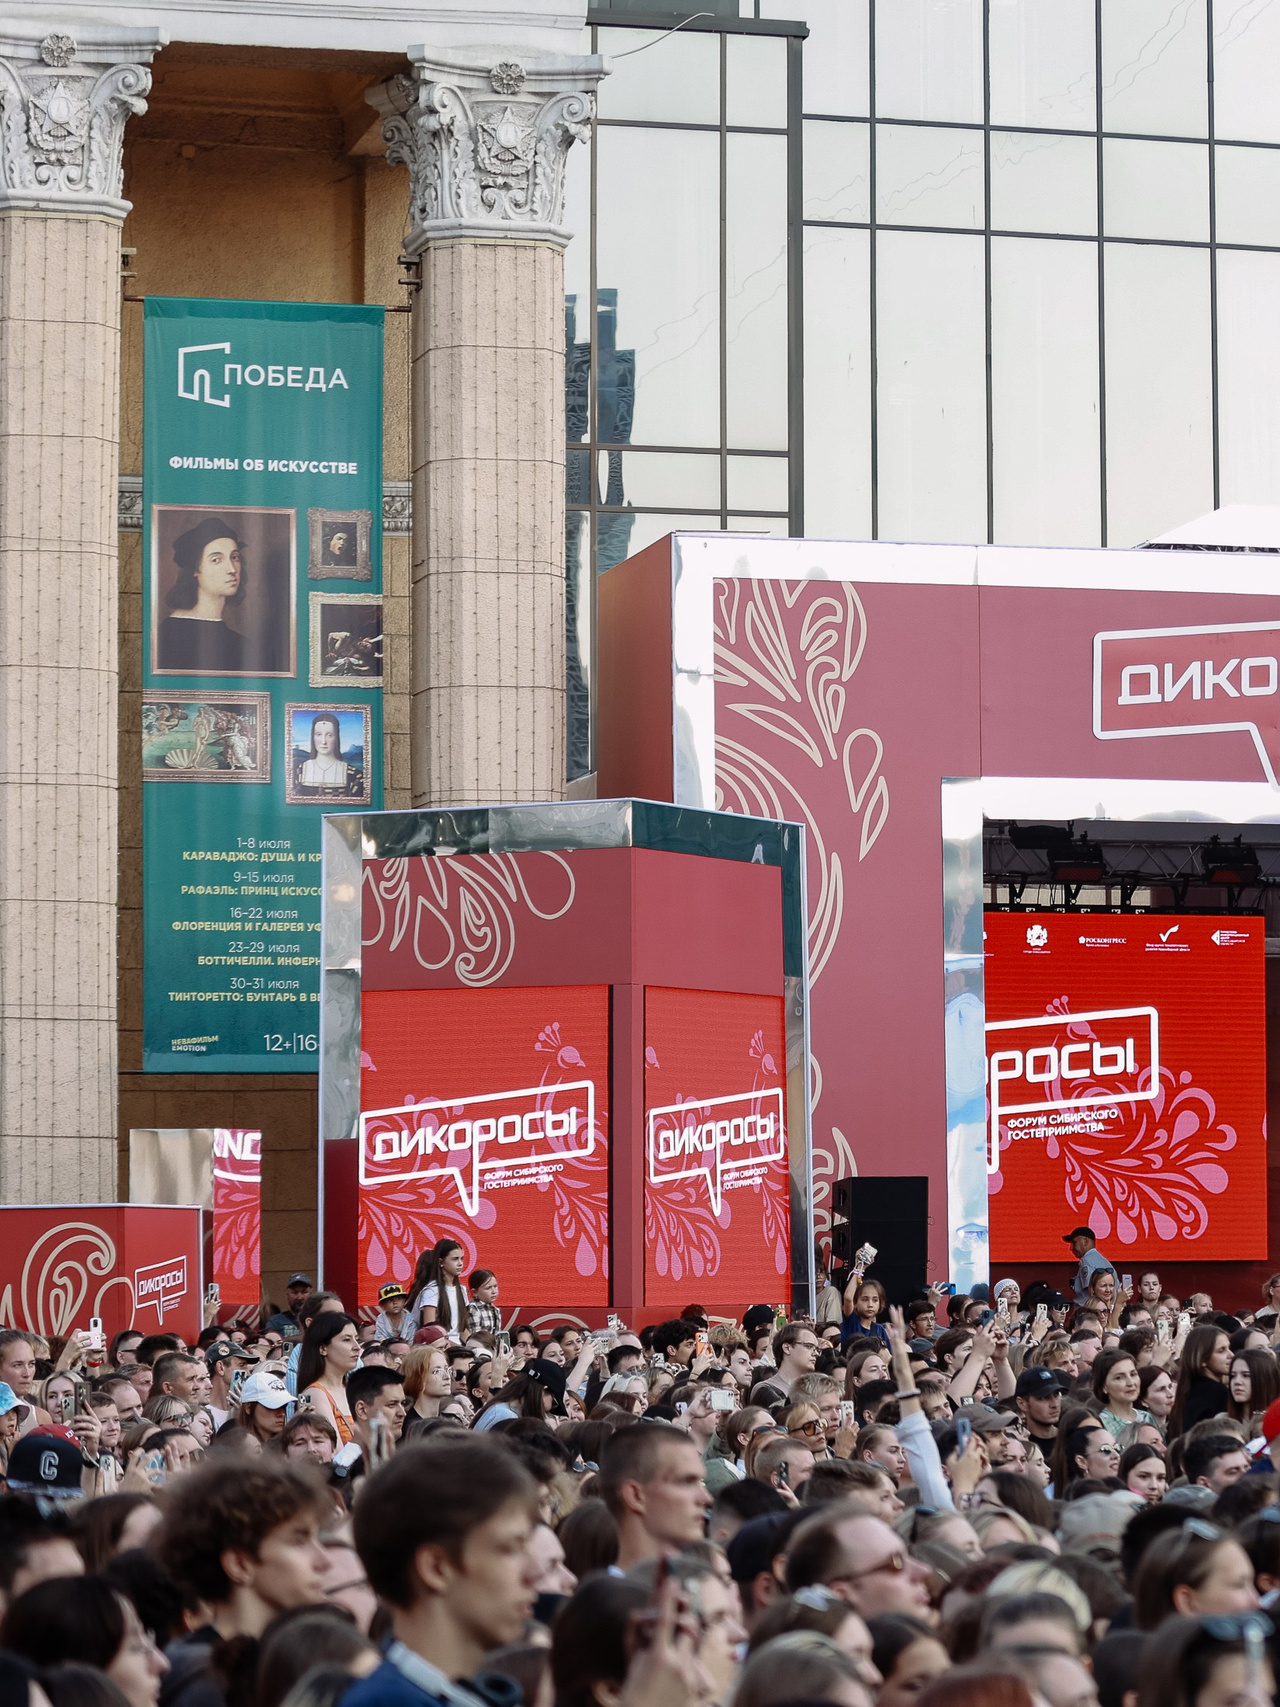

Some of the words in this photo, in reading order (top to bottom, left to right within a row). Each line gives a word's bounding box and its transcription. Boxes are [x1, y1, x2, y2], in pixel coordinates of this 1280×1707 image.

[224, 363, 349, 392] ПОБЕДА
[168, 456, 239, 471] ФИЛЬМЫ
[242, 458, 264, 472] ОБ
[268, 459, 358, 475] ИСКУССТВЕ
[258, 840, 291, 849] июля
[182, 851, 259, 862] КАРАВАДЖО:
[260, 852, 295, 863] ДУША
[297, 853, 306, 862] И
[262, 874, 295, 883] июля
[180, 885, 238, 895] РАФАЭЛЬ:
[240, 886, 278, 897] ПРИНЦ
[266, 909, 298, 919] июля
[171, 921, 242, 932] ФЛОРЕНЦИЯ
[244, 922, 253, 931] И
[255, 922, 304, 932] ГАЛЕРЕЯ
[268, 944, 300, 953] июля
[197, 956, 275, 966] БОТТИЧЕЛЛИ.
[267, 980, 300, 989] июля
[168, 992, 244, 1001] ТИНТОРЕТТО:
[246, 992, 297, 1002] БУНТАРЬ
[300, 993, 307, 1002] В
[985, 1037, 1135, 1086] РОСЫ
[1007, 1115, 1047, 1129] ФОРУМ
[1049, 1108, 1118, 1125] СИБИРСКОГО
[372, 1106, 578, 1161] ДИКОРОСЫ
[657, 1112, 776, 1158] ДИКОРОСЫ
[1007, 1122, 1105, 1141] ГОСТЕПРИИМСТВА
[483, 1170, 513, 1180] ФОРУМ
[513, 1164, 564, 1177] СИБИРСКОГО
[483, 1174, 554, 1190] ГОСТЕПРИИМСТВА
[138, 1268, 184, 1296] ДИКОРОСЫ
[40, 1450, 59, 1480] C
